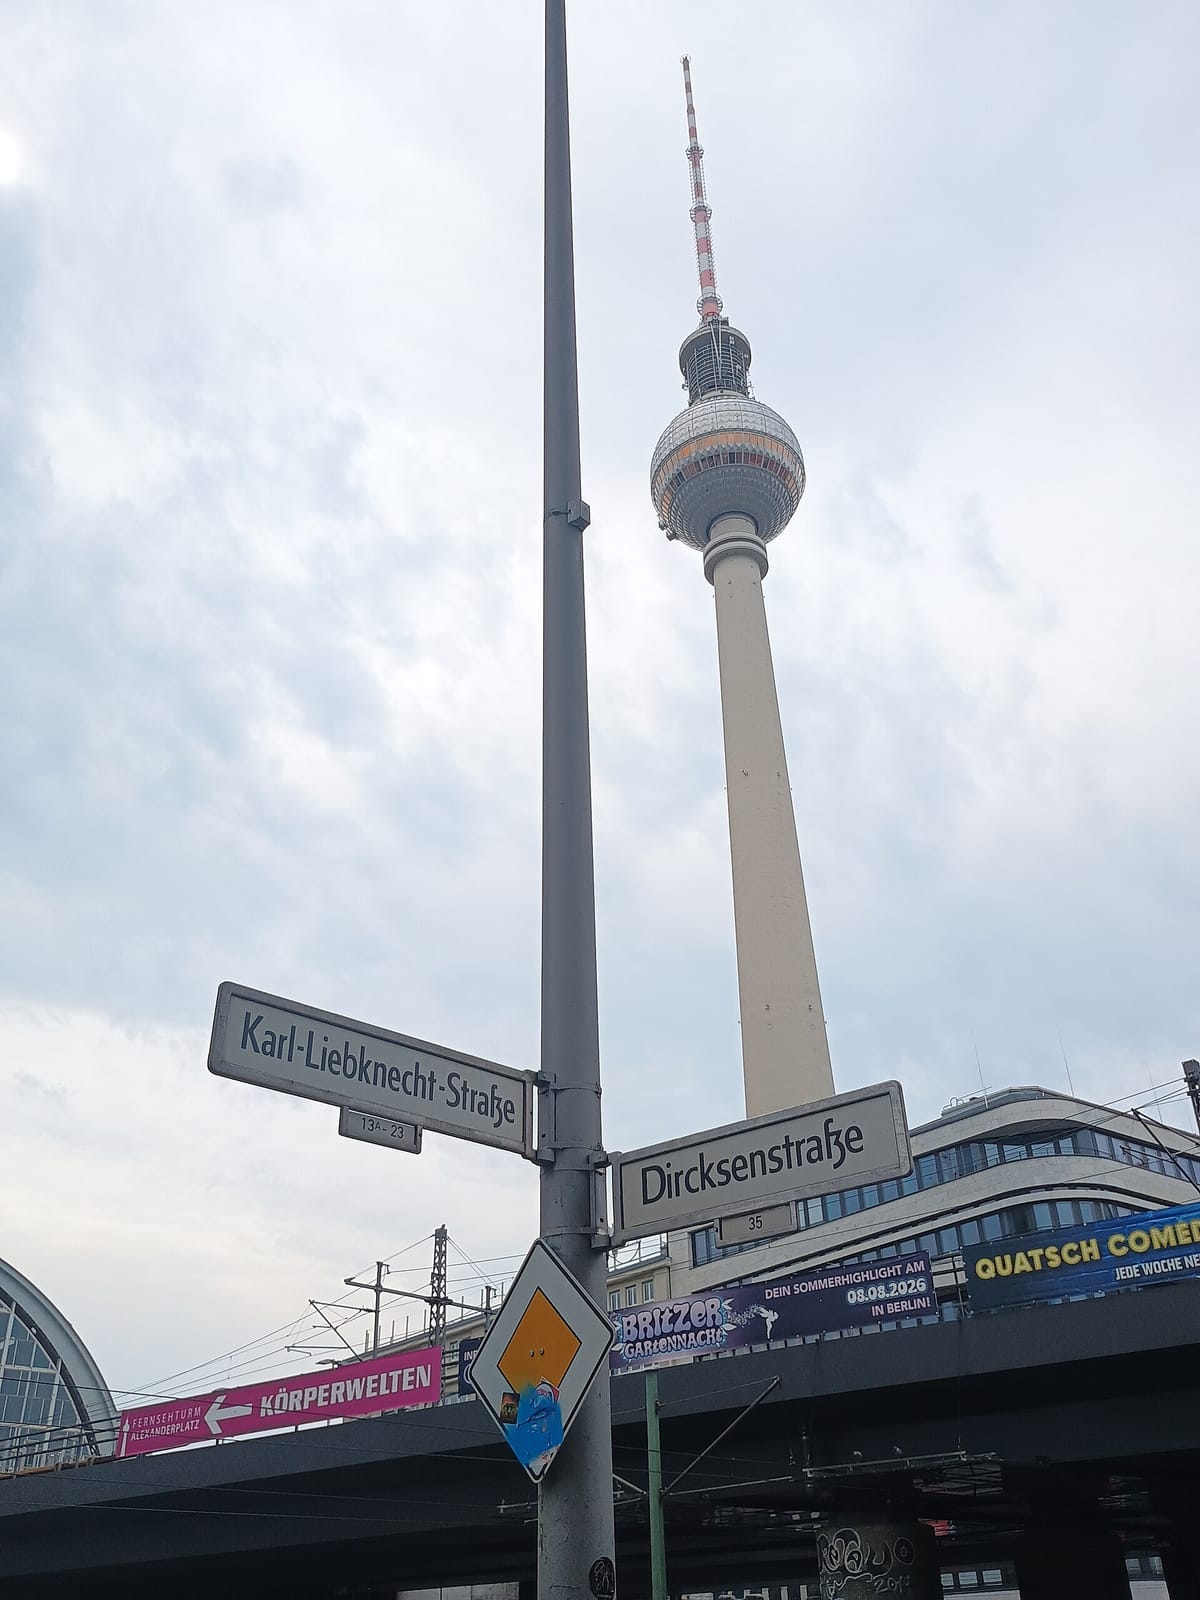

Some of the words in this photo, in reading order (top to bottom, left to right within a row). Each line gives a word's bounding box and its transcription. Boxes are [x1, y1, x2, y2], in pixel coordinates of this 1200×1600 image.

[241, 1011, 515, 1128] Karl-Liebknecht-Straße
[641, 1118, 864, 1205] Dircksenstraße
[748, 1215, 763, 1231] 35
[975, 1238, 1101, 1280] QUATSCH
[1115, 1266, 1142, 1281] JEDE
[1142, 1258, 1183, 1277] WOCHE
[764, 1286, 792, 1300] DEIN
[793, 1264, 903, 1295] SOMMERHIGHLIGHT
[905, 1260, 926, 1274] AM
[846, 1277, 927, 1304] 08.08.2026
[871, 1305, 885, 1317] IN
[886, 1297, 931, 1315] BERLIN!
[259, 1364, 432, 1418] KÖRPERWELTEN
[130, 1419, 200, 1442] ALEXANDERPLATZ
[132, 1407, 201, 1428] FERNSEHTURM
